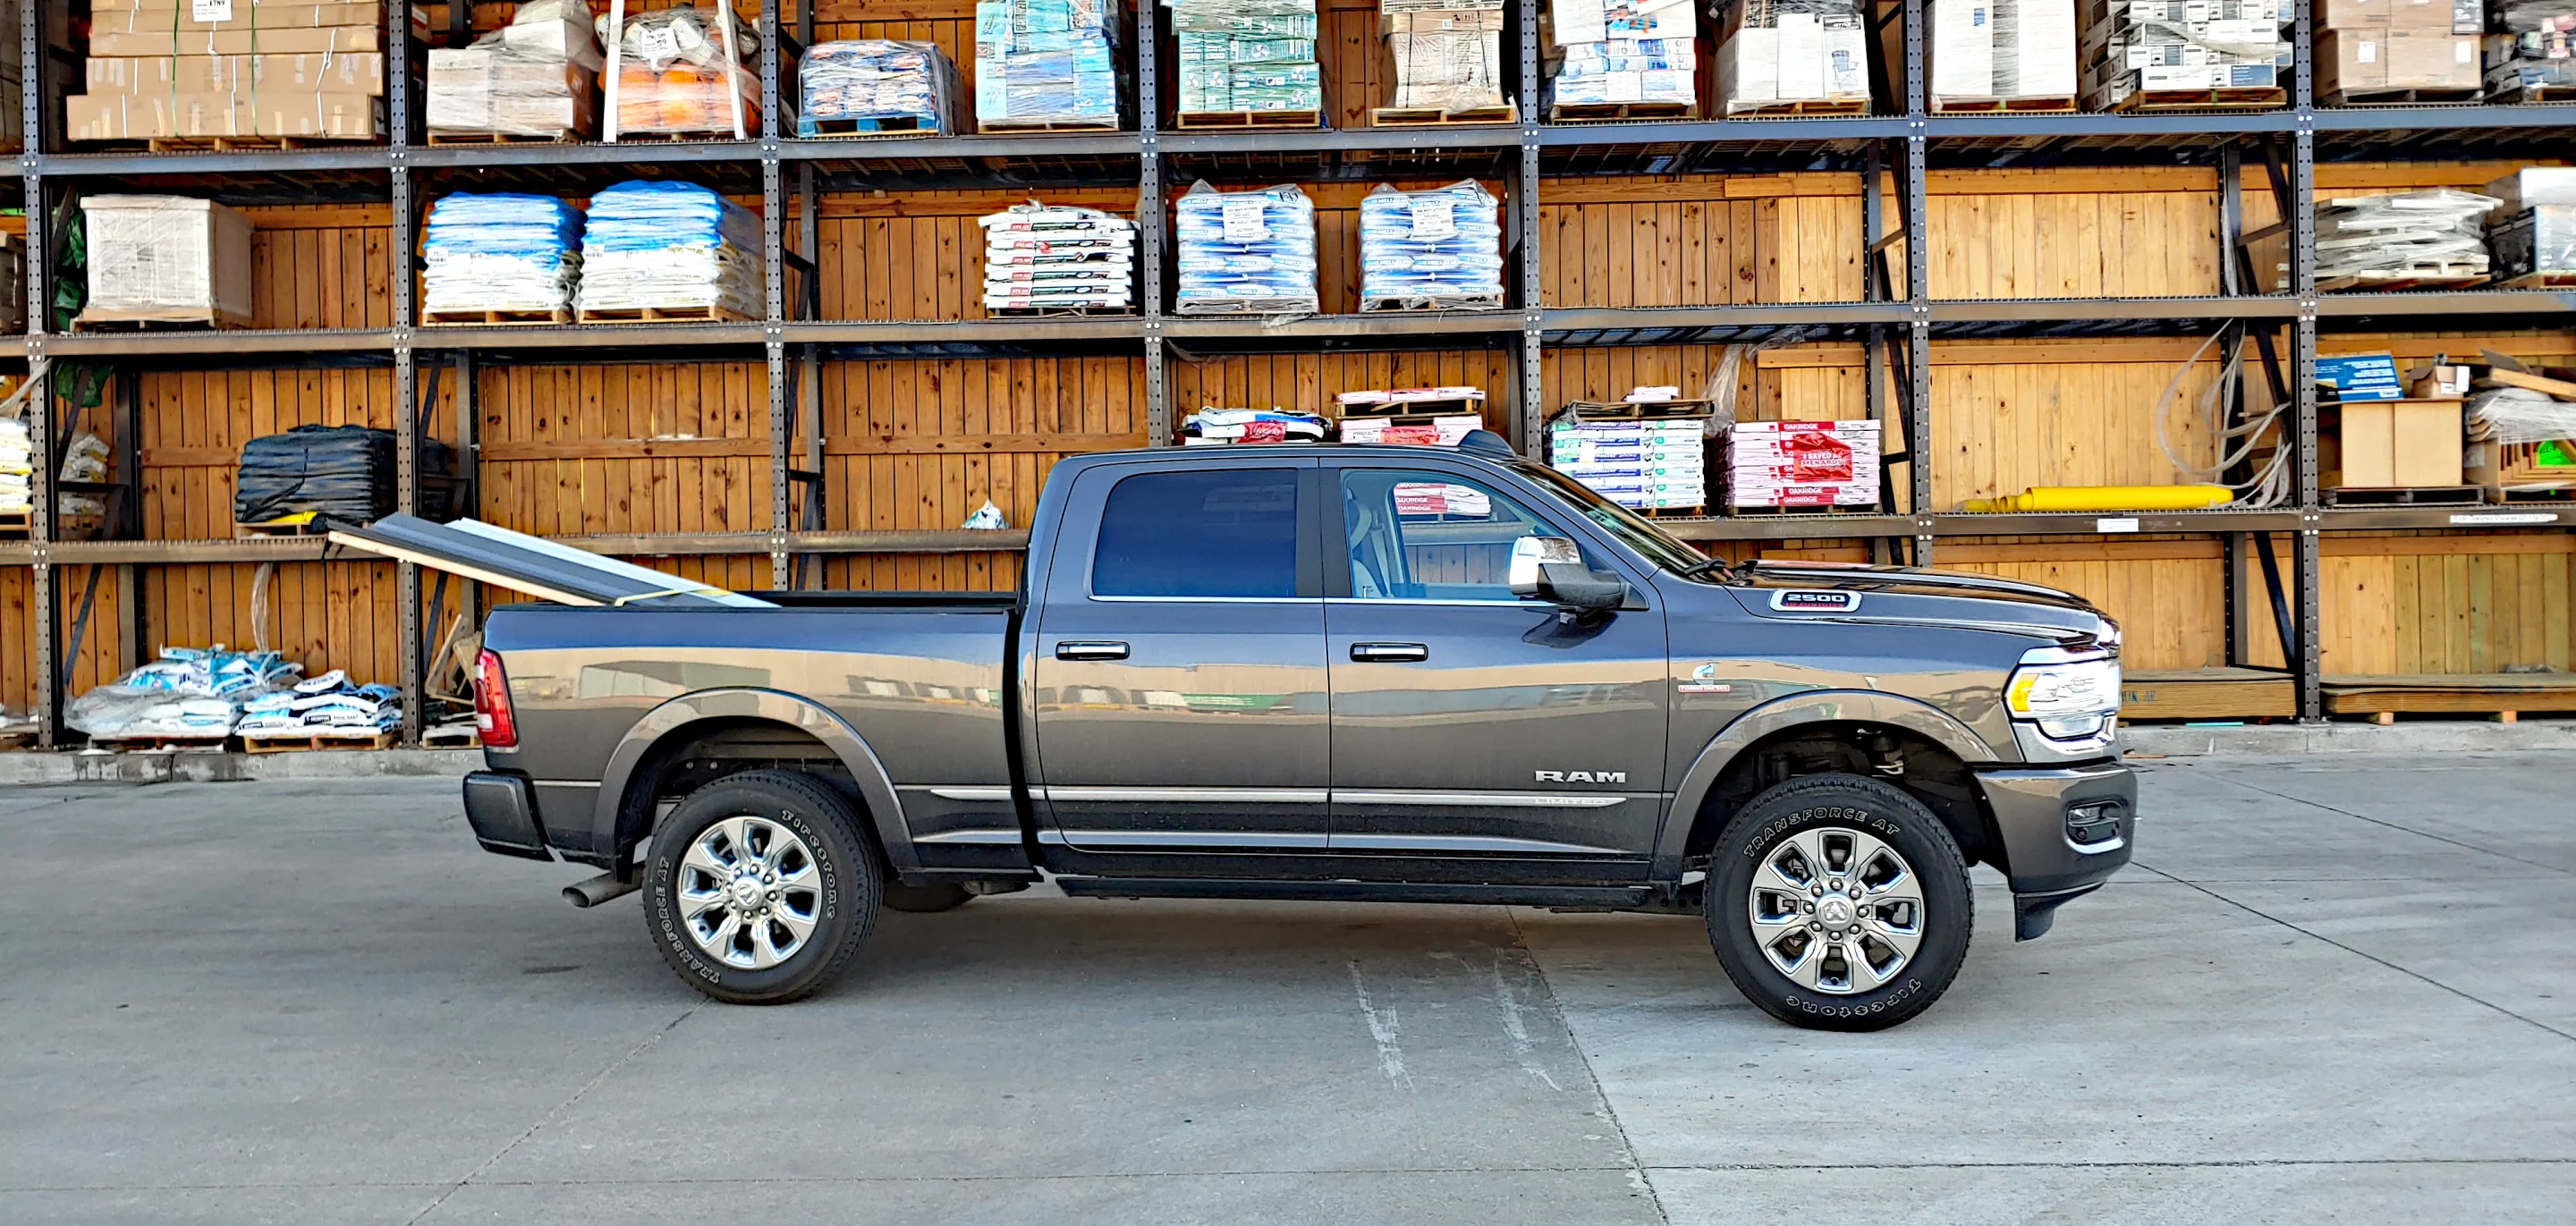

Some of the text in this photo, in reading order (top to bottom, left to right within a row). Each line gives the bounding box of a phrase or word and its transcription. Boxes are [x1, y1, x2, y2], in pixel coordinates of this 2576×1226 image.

[1787, 594, 1845, 602] 2500
[1535, 770, 1626, 783] RAM
[1744, 807, 1901, 858] TRANSFORCE AT
[782, 809, 837, 919] Firestone
[656, 856, 720, 984] TRANSFORCE AT
[1785, 978, 1922, 1019] Firestone
